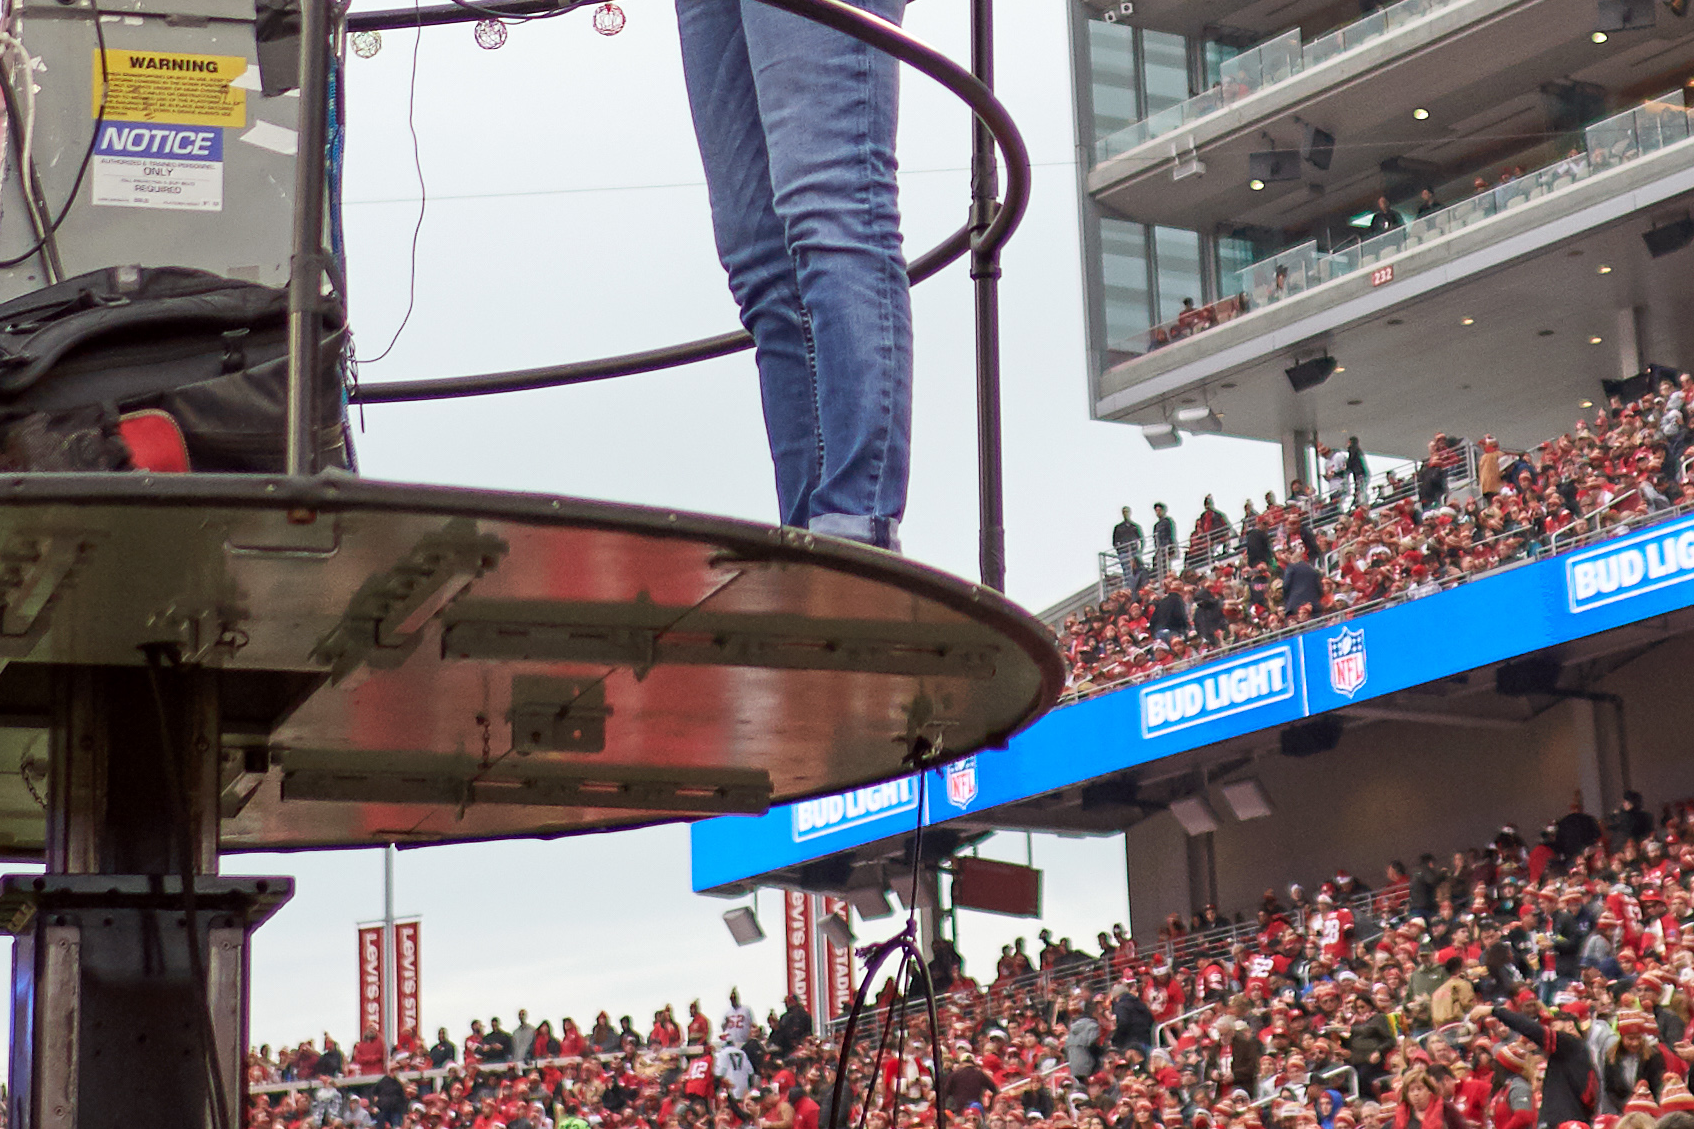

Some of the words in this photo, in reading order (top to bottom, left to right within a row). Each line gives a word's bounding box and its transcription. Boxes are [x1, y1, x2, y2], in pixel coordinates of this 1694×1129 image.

[129, 56, 220, 74] WARNING
[100, 127, 216, 156] NOTICE
[143, 167, 174, 177] ONLY
[134, 184, 183, 195] REQUIRED
[1374, 267, 1393, 285] 232
[1573, 549, 1645, 600] BUD
[1333, 657, 1365, 688] NFL
[1146, 682, 1204, 729] BUD
[1204, 656, 1287, 712] LIGHT
[951, 773, 977, 798] NFL
[798, 794, 845, 833] BUD
[845, 776, 912, 819] LIGHT
